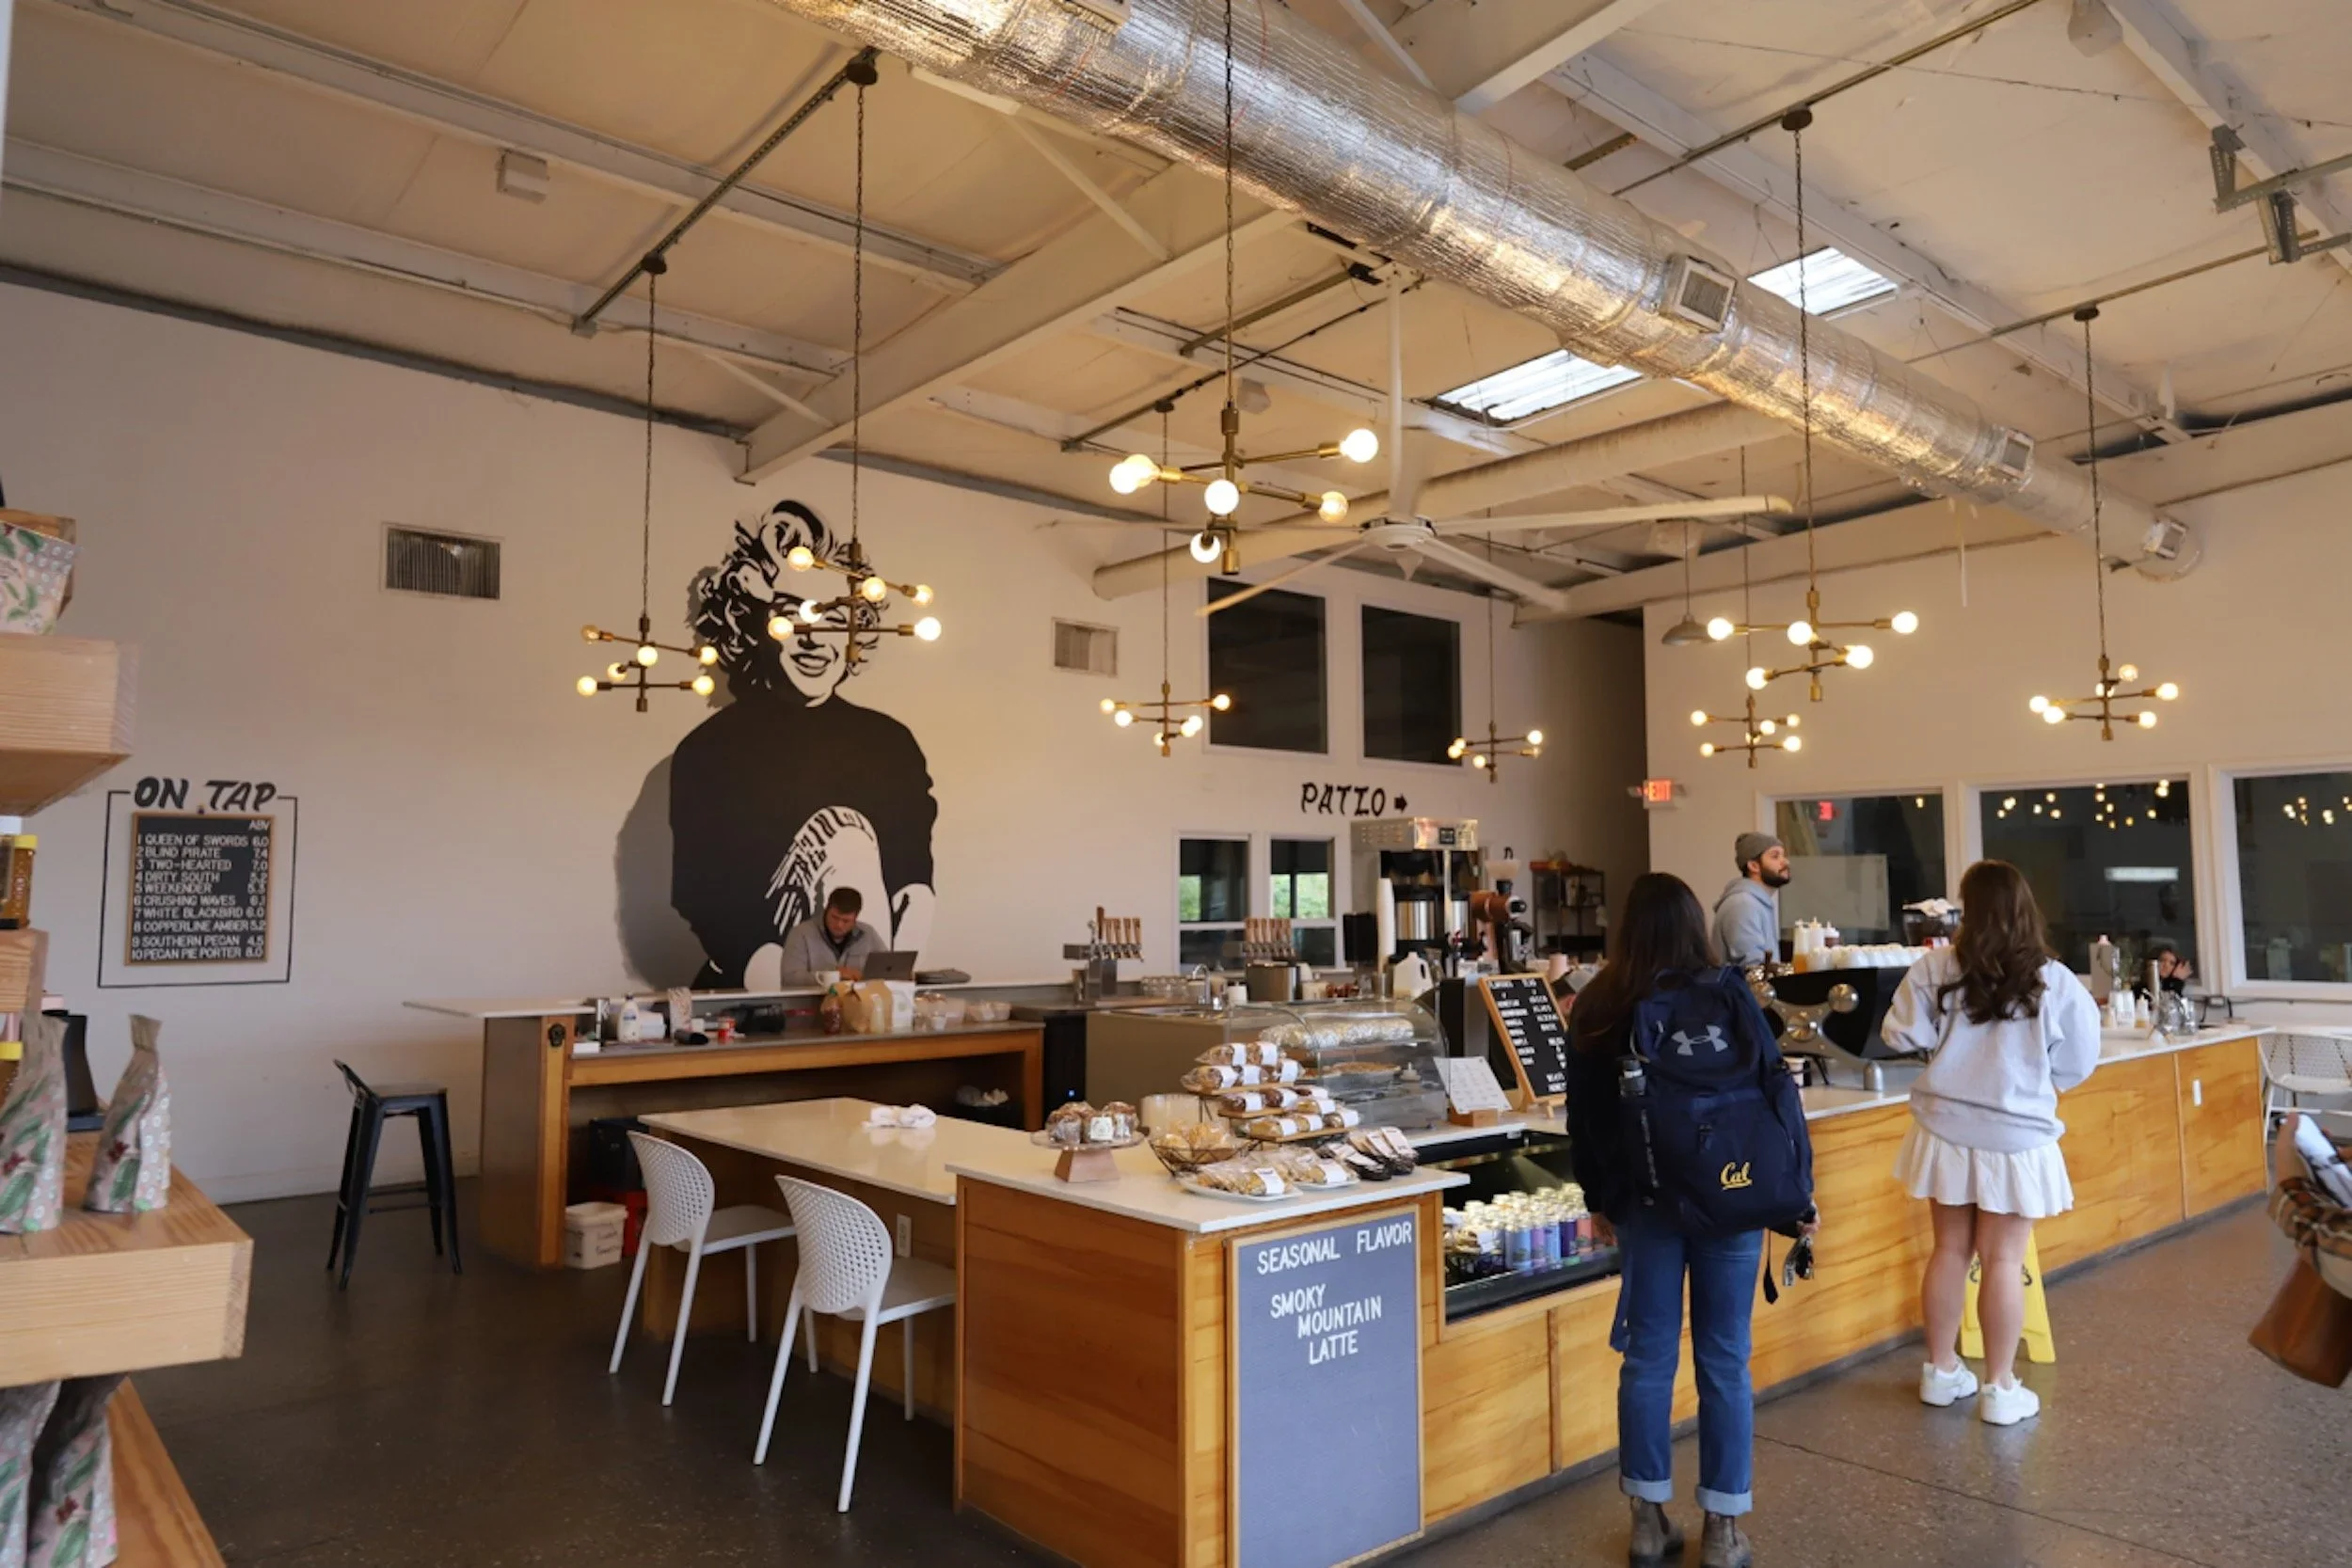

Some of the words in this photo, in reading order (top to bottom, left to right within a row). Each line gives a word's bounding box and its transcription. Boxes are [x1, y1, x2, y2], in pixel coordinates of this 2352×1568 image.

[135, 777, 188, 809] ON
[205, 781, 276, 812] TAP
[1301, 783, 1386, 816] PATIO
[145, 834, 183, 846] QUEEN
[184, 834, 199, 846] OF
[203, 835, 248, 847] SWORDS
[135, 847, 144, 858] 2
[145, 847, 179, 857] BLIND
[182, 847, 221, 859] PIRATE
[135, 860, 143, 870] 3
[149, 860, 231, 871] TWO-HEARTED
[135, 872, 142, 882] 4
[145, 871, 178, 882] DIRTY
[181, 871, 220, 882] SOUTH
[135, 883, 142, 894] 5
[145, 882, 213, 894] WEEKENDER
[134, 895, 142, 906] 6
[143, 895, 198, 906] CRUSHING
[200, 895, 236, 906] WAVES
[134, 908, 142, 918] 7
[143, 907, 181, 919] WHITE
[183, 907, 244, 919] BLACKBIRD
[143, 920, 212, 932] COPPERLINE
[213, 920, 248, 932] AMBER
[132, 936, 140, 947] 9
[142, 935, 201, 947] SOUTHERN
[203, 935, 241, 946] PECAN
[132, 948, 142, 959] 10
[143, 948, 179, 960] PECAN
[182, 947, 198, 958] PIE
[199, 947, 241, 958] PORTER
[1720, 1162, 1753, 1190] Cal
[1257, 1237, 1341, 1275] SEASONAL
[1357, 1221, 1412, 1253] FLAVOR
[1270, 1284, 1327, 1319] SMOKY
[1297, 1296, 1382, 1338] MOUNTAIN
[1309, 1330, 1359, 1365] LATTE
